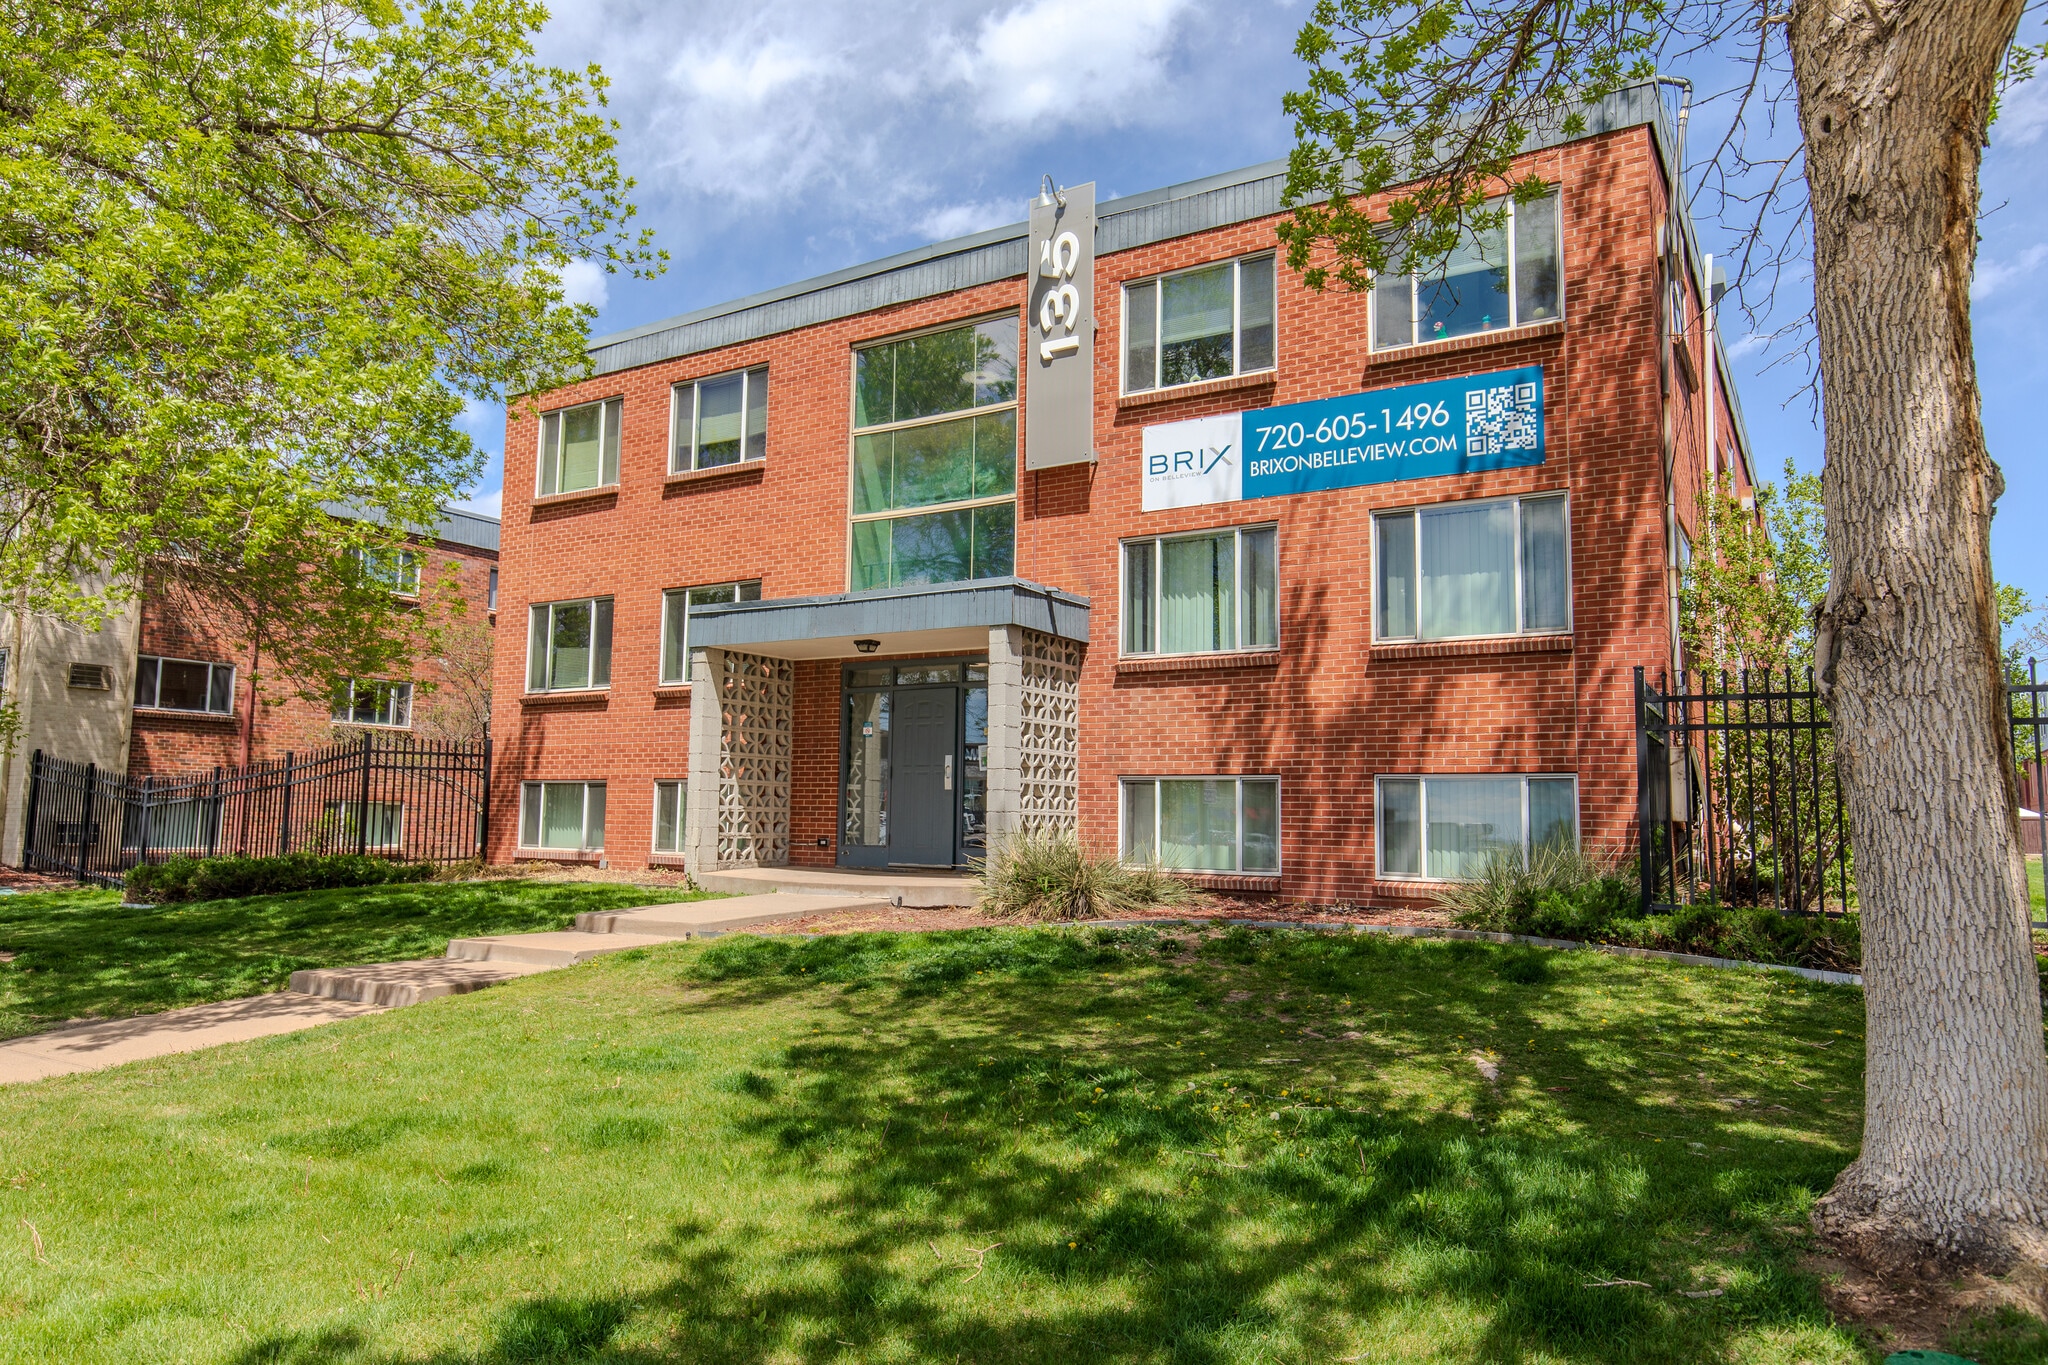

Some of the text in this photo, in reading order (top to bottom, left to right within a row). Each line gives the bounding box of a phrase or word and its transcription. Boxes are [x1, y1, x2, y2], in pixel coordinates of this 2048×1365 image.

[1040, 231, 1079, 360] 135
[1256, 400, 1450, 452] 720-605-1496
[1149, 444, 1233, 475] BRIX
[1162, 471, 1202, 481] BELLEVIEW
[1250, 434, 1458, 477] BRIXONBELLEVIEW.COM
